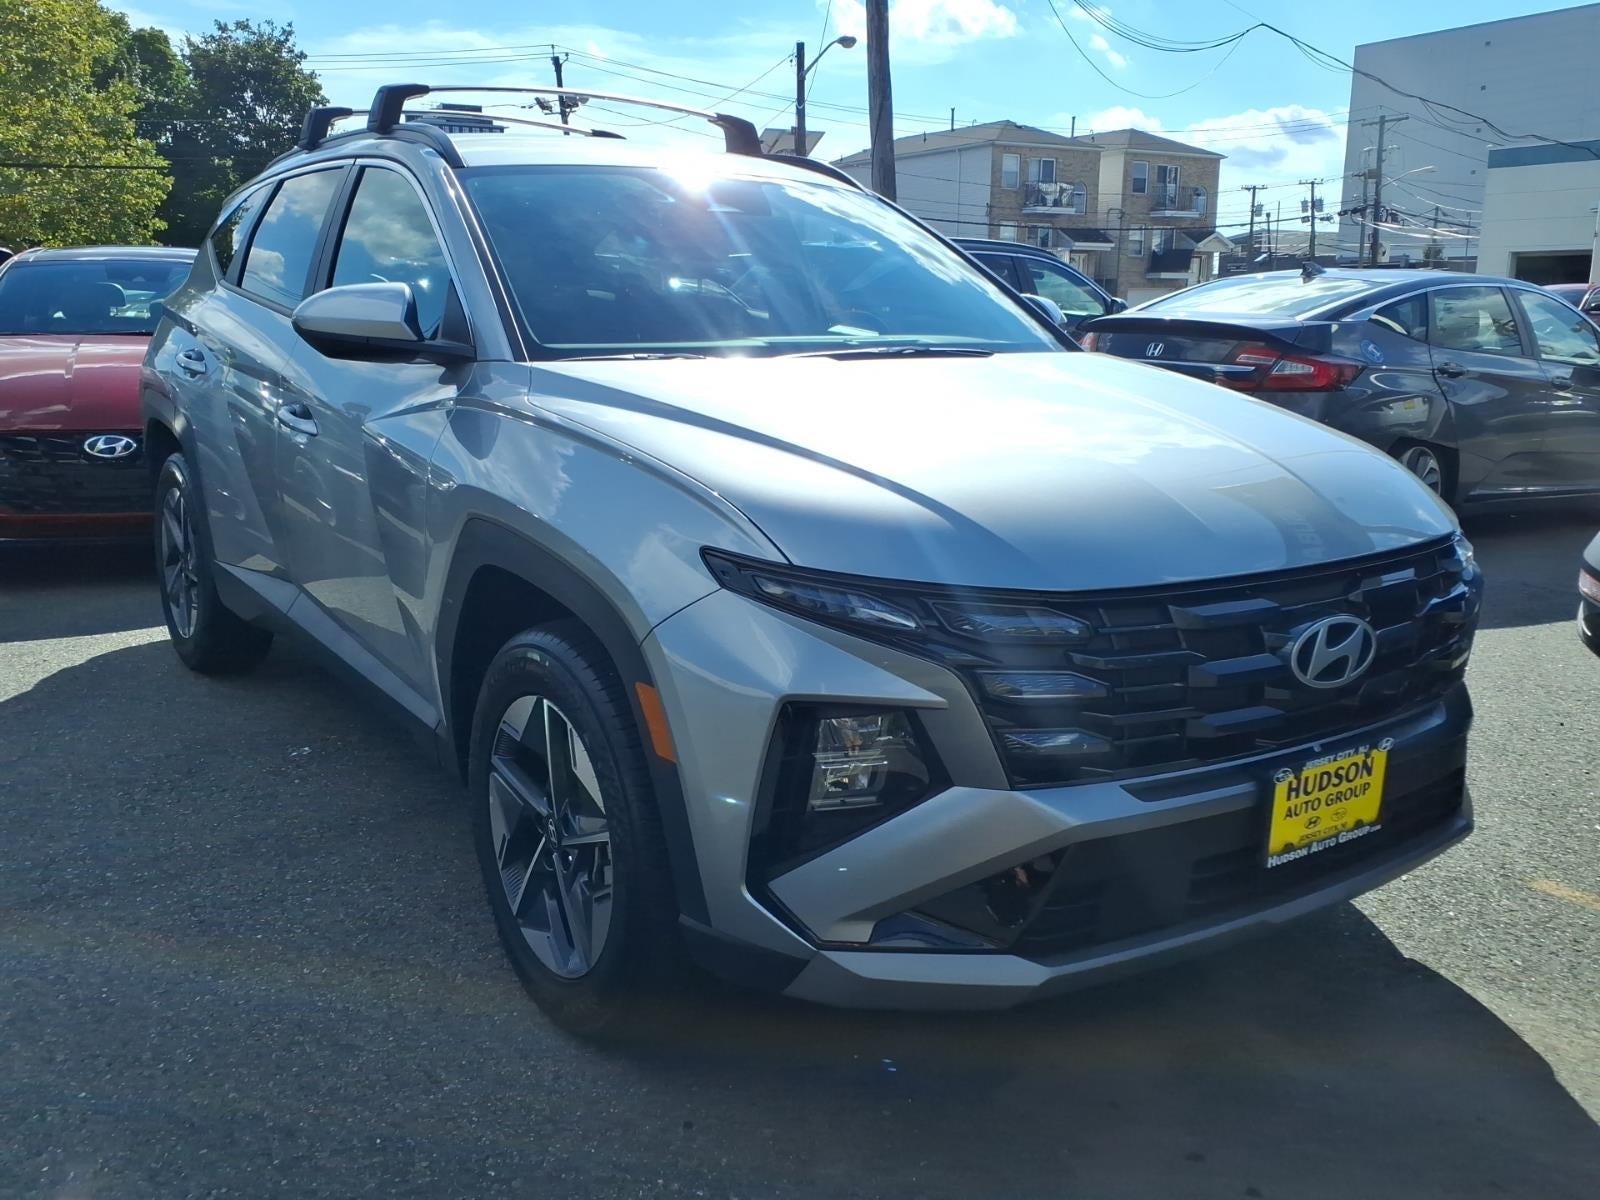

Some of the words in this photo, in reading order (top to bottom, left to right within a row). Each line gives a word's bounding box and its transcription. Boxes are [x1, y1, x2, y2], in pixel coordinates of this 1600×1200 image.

[1286, 757, 1375, 802] HUDSON
[1284, 797, 1322, 820] AUTO
[1325, 782, 1371, 807] GROUP
[1267, 847, 1309, 868] HUDSON
[1310, 838, 1337, 854] AUTO
